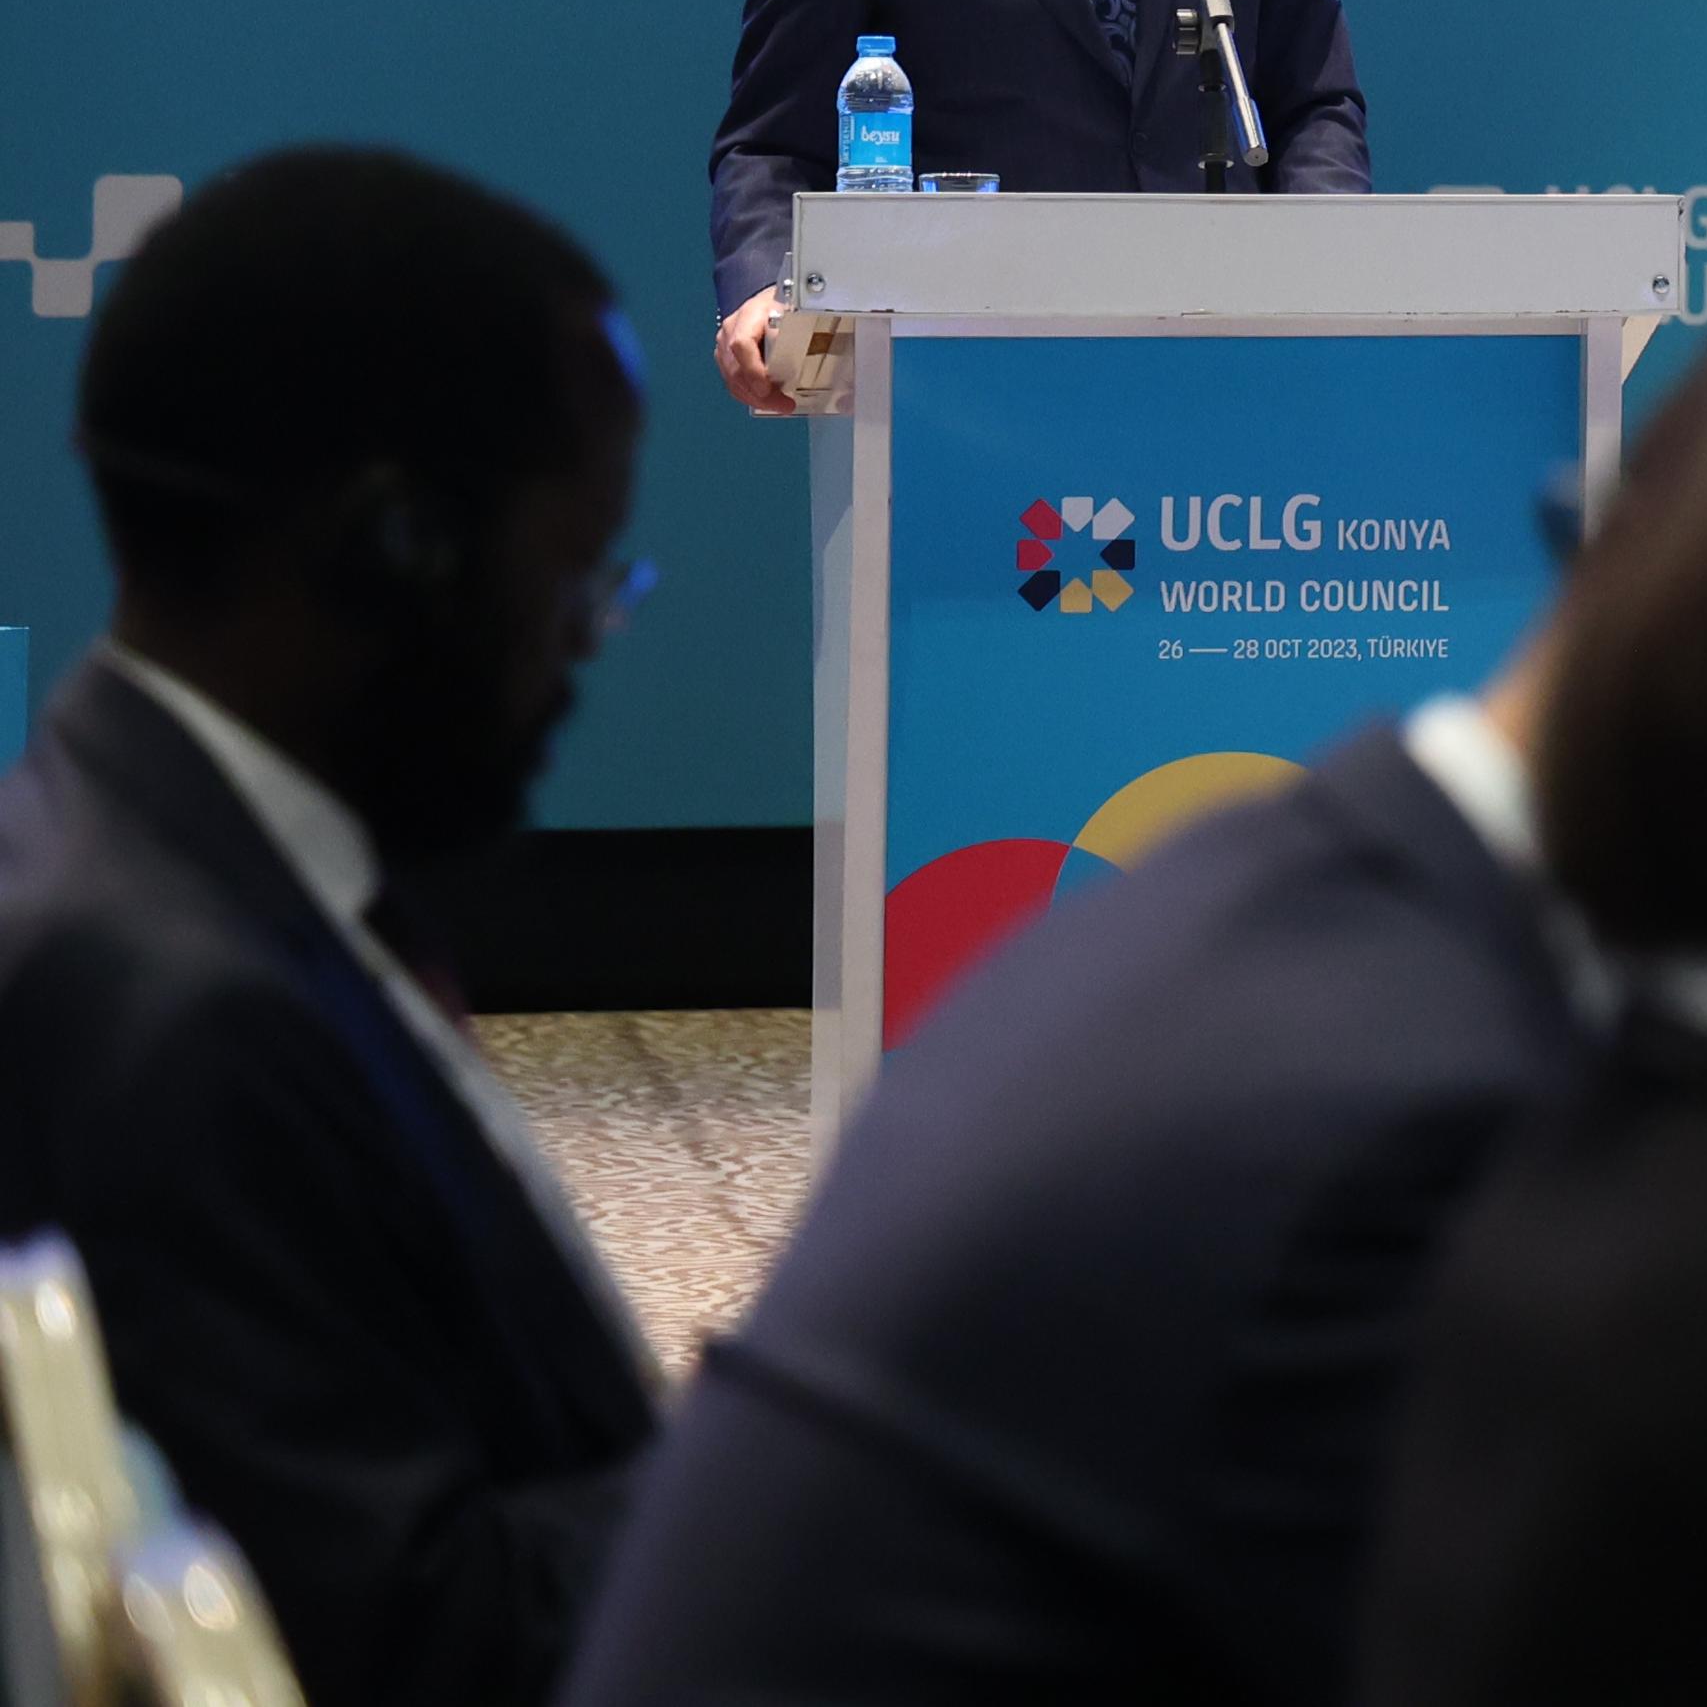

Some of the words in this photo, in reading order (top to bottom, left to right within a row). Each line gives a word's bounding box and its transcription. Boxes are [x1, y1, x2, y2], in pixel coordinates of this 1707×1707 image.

[1160, 493, 1322, 552] UCLG
[1338, 519, 1451, 551] KONYA
[1160, 580, 1286, 613] WORLD
[1300, 579, 1450, 613] COUNCIL
[1158, 639, 1184, 660] 26
[1233, 639, 1260, 660] 28
[1264, 638, 1303, 659] OCT
[1307, 638, 1362, 662] 2023,
